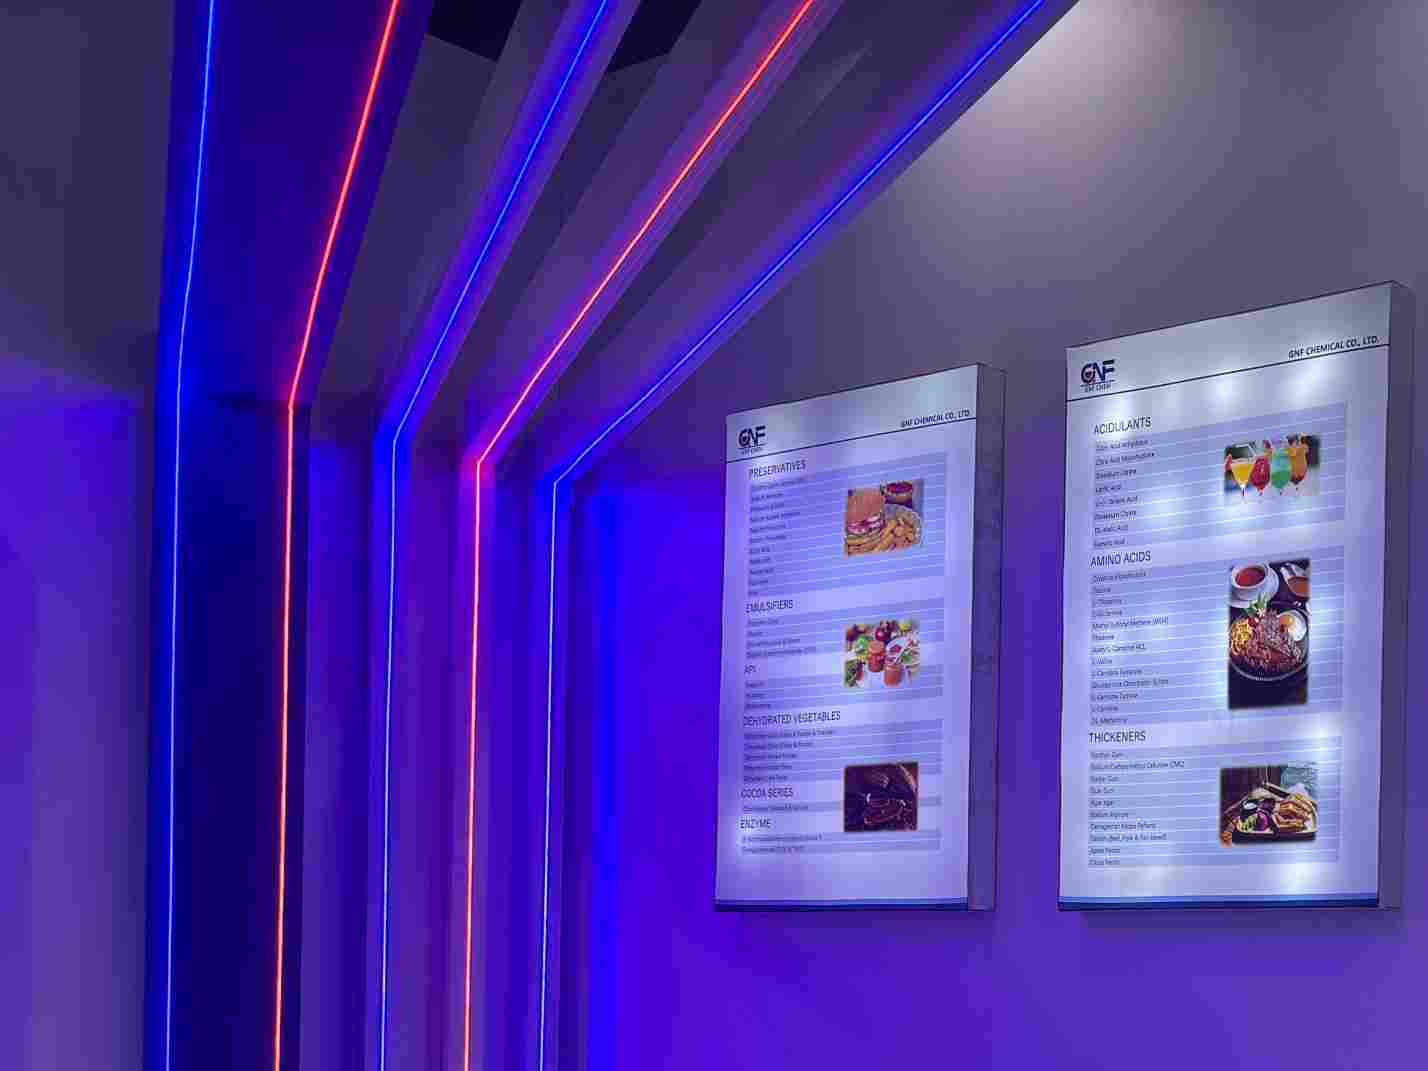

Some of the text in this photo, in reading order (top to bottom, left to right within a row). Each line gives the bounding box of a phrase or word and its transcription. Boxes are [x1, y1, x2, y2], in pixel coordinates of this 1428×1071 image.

[1094, 415, 1151, 436] ACIDULANTS
[1090, 550, 1151, 568] AMINO ACIDS
[1089, 729, 1146, 744] THICKENERS
